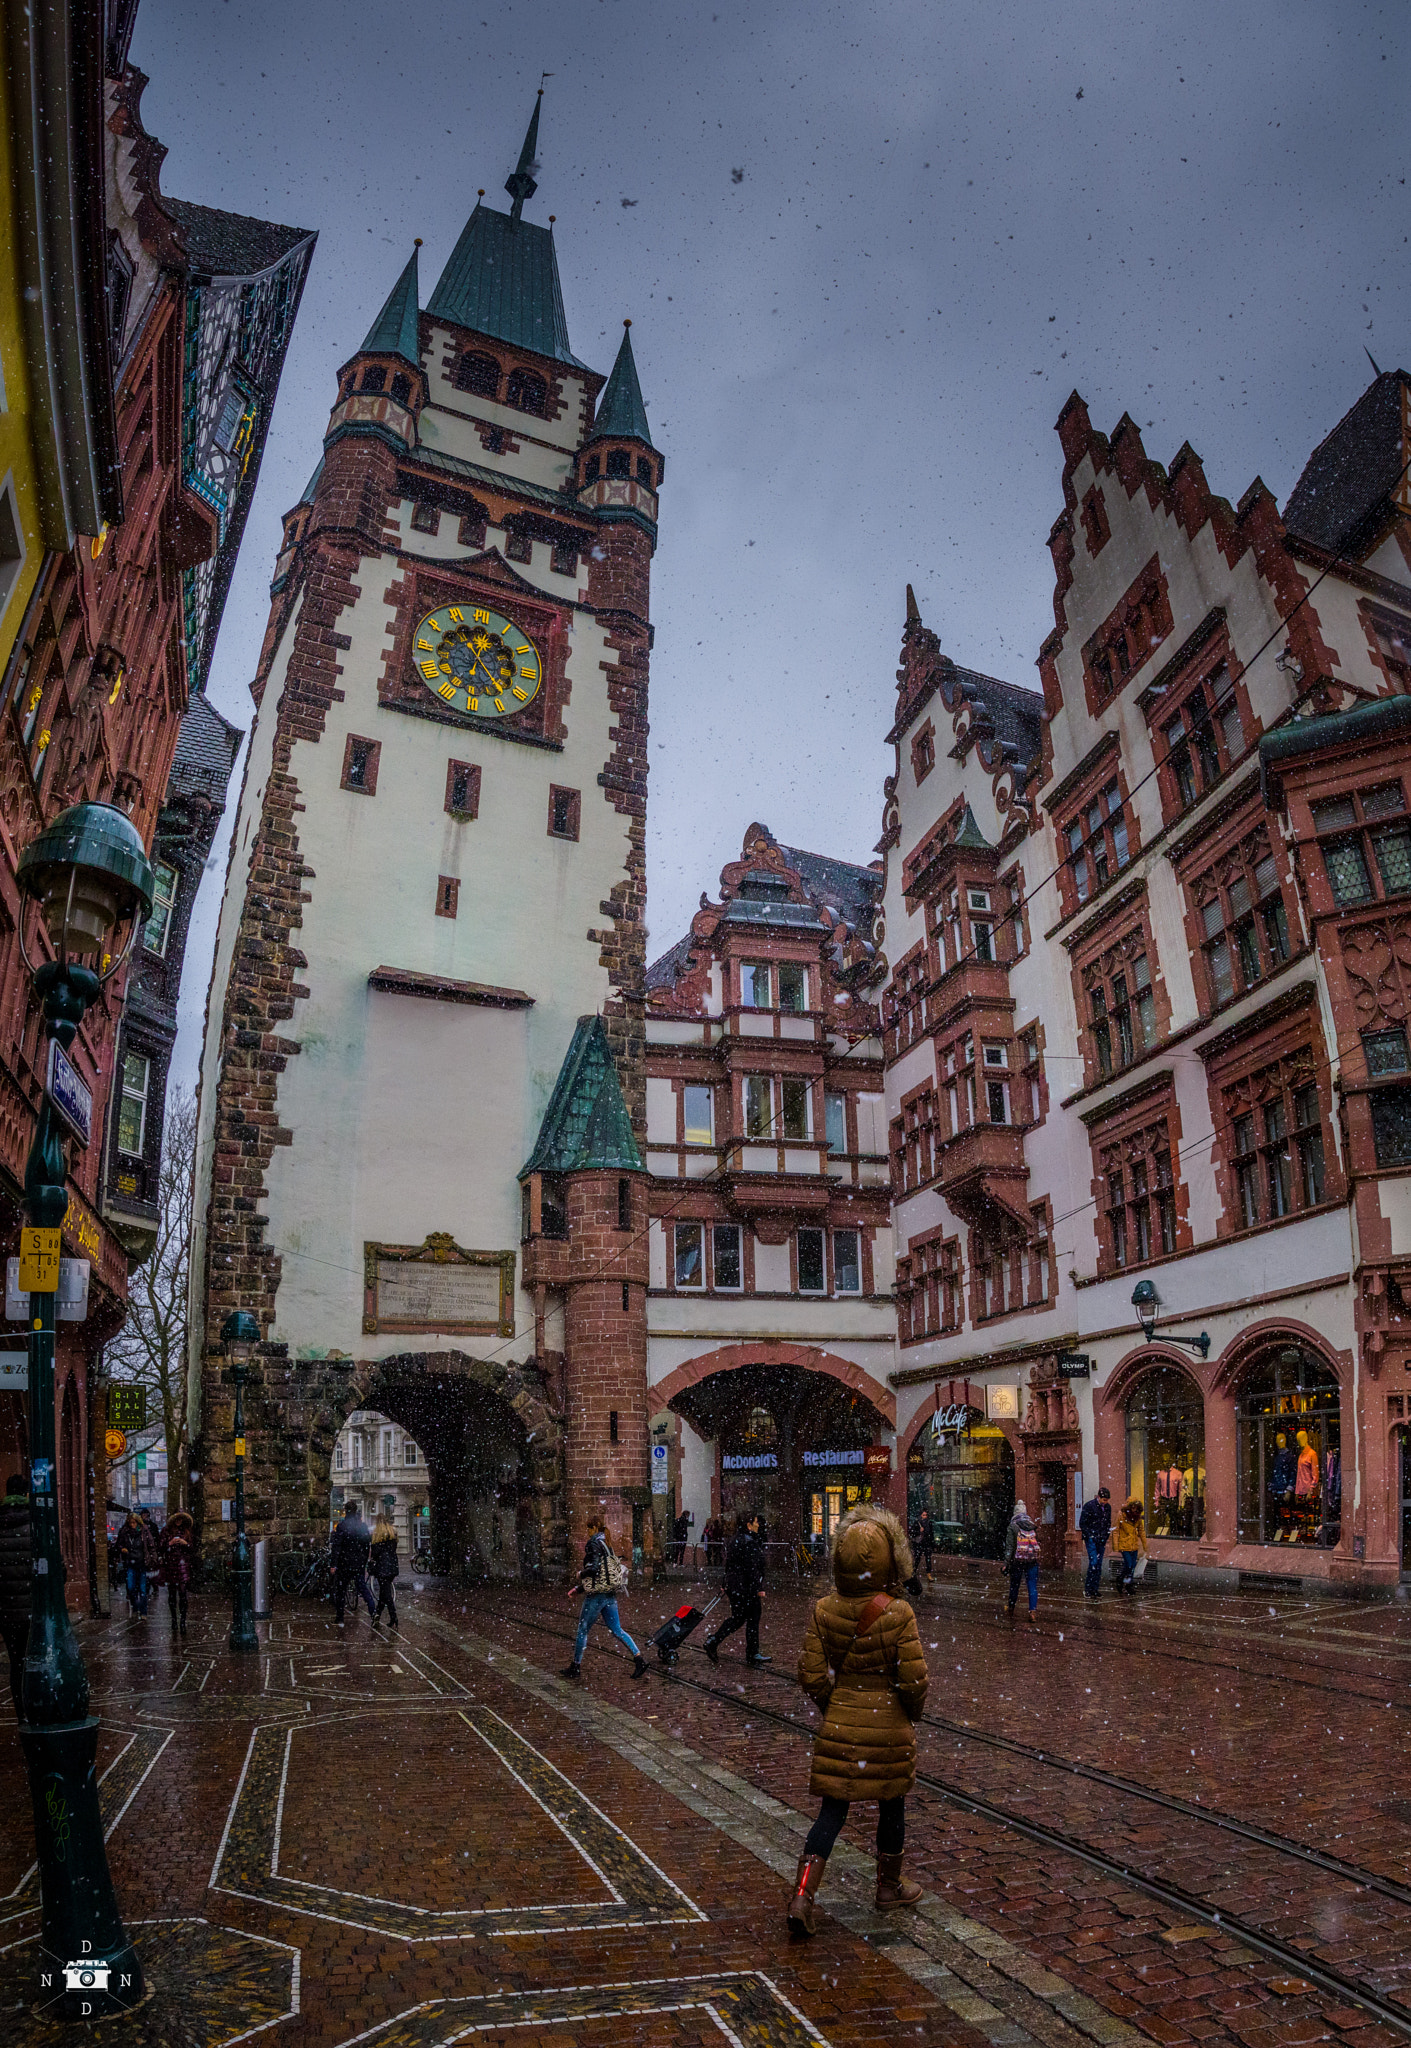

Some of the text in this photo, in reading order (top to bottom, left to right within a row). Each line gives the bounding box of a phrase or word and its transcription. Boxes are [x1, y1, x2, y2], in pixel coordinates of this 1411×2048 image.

[32, 1235, 41, 1249] S
[931, 1403, 968, 1436] McCafé
[722, 1450, 864, 1469] McDonald's Restauran
